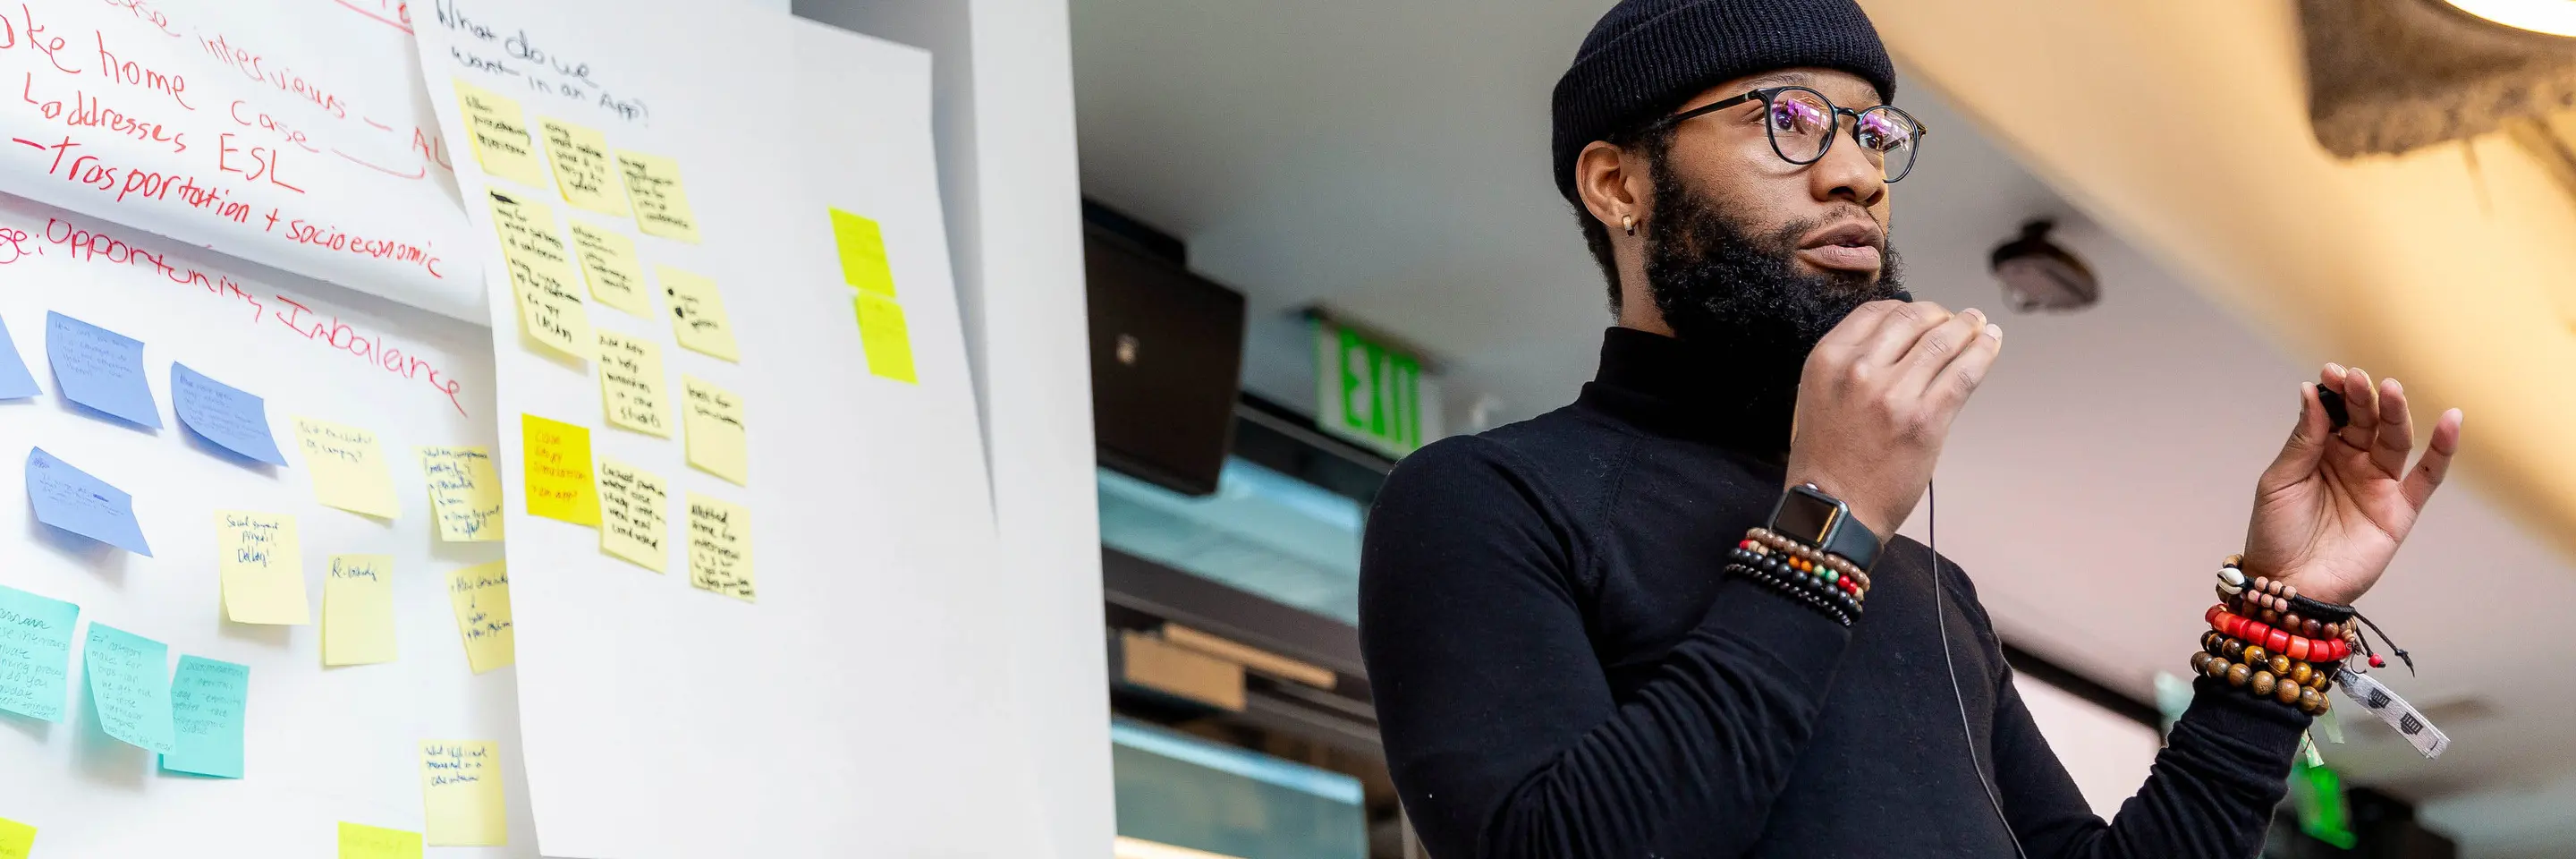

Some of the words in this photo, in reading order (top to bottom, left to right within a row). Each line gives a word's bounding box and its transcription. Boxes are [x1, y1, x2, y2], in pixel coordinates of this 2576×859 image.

[96, 30, 196, 111] home
[504, 29, 546, 64] do
[219, 132, 306, 194] ESL
[47, 217, 262, 323] Opportunity
[275, 293, 469, 418] Imbalance
[1339, 327, 1423, 451] EXIT
